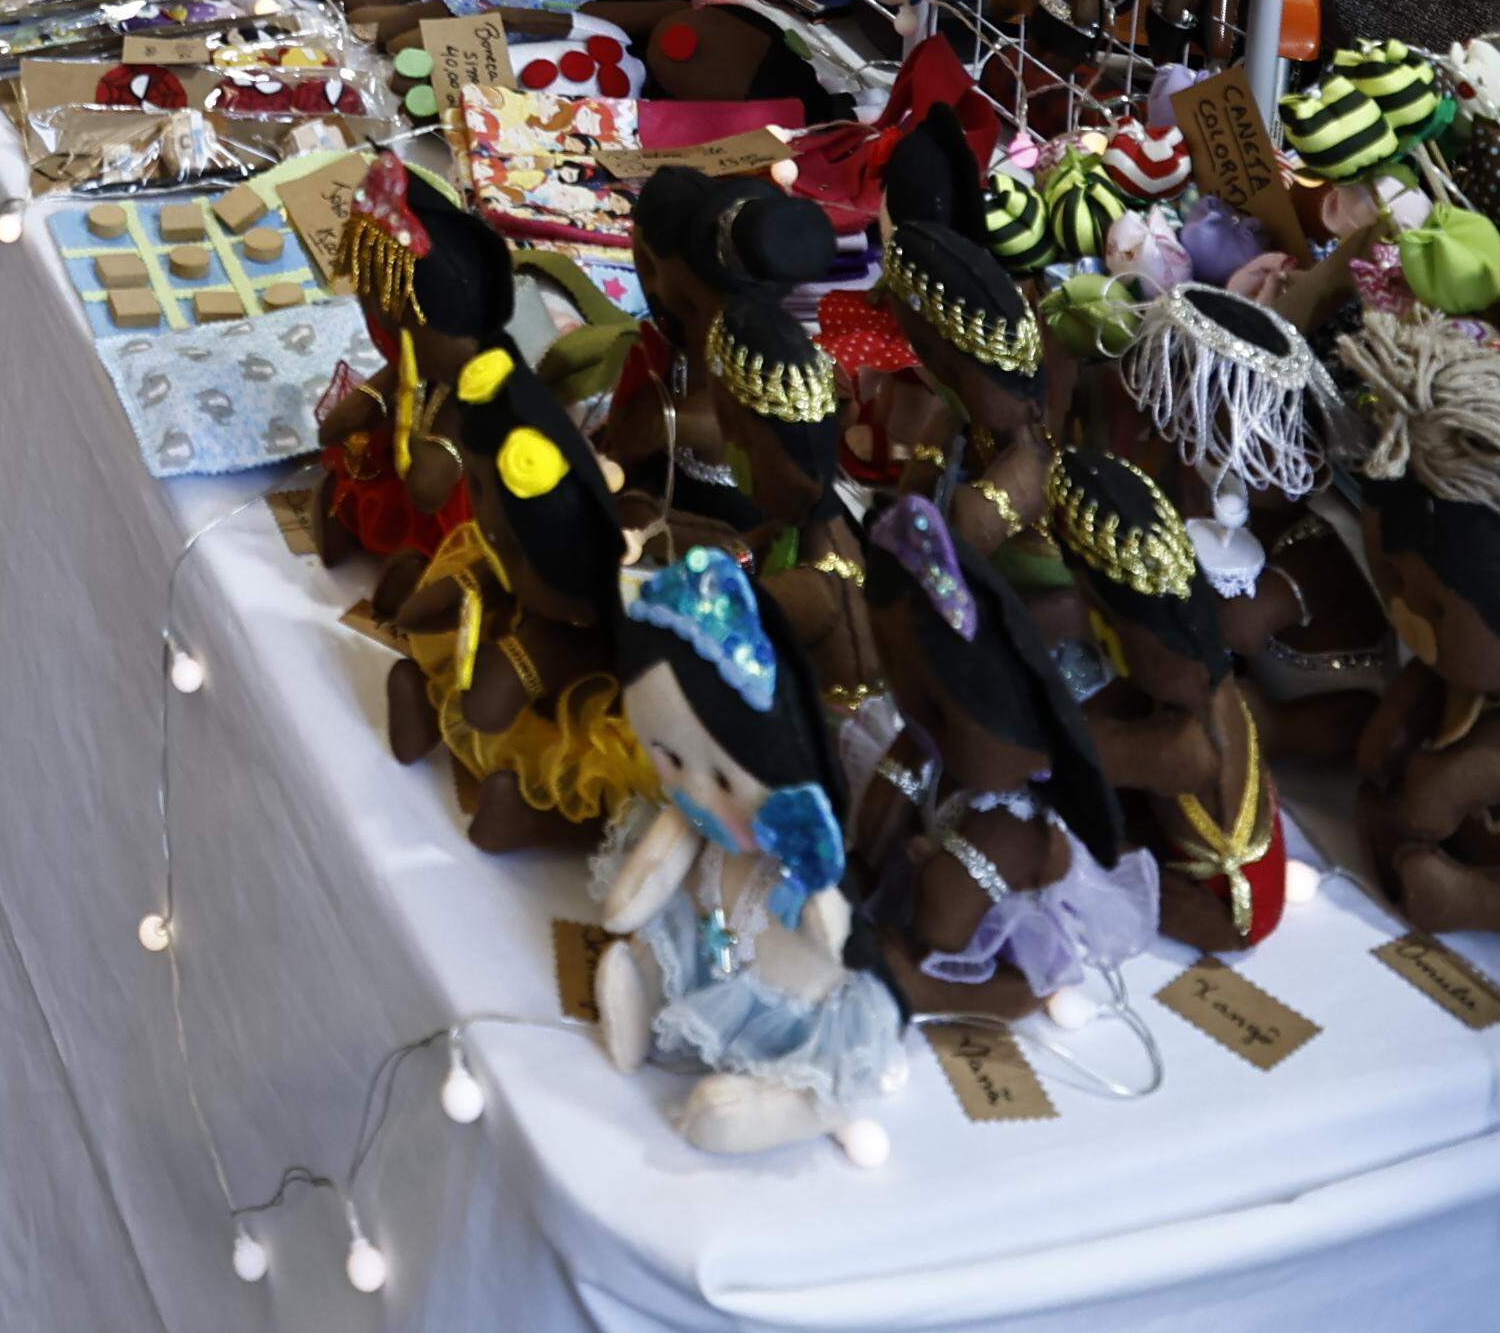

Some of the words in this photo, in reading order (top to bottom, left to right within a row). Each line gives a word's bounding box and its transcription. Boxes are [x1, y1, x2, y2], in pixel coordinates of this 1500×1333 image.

[474, 21, 500, 83] Boneca
[1224, 85, 1271, 191] CANETA
[1193, 978, 1280, 1046] Xangô
